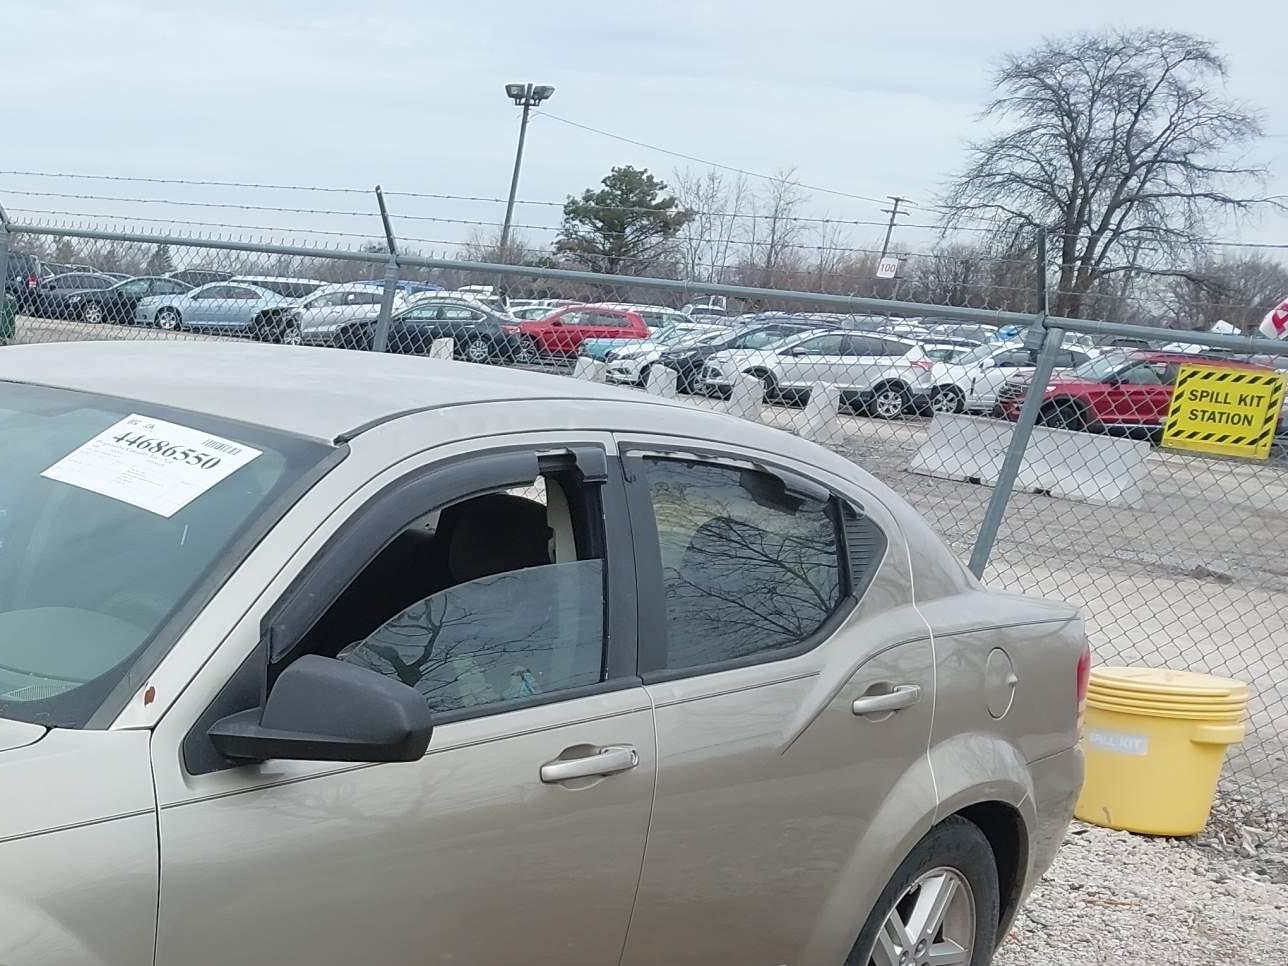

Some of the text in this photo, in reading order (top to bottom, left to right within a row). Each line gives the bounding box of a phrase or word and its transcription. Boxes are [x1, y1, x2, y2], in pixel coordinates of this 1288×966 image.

[881, 264, 896, 273] 100
[1187, 388, 1265, 408] SPILL KIT
[1187, 408, 1254, 427] STATION
[112, 431, 222, 470] 44686550
